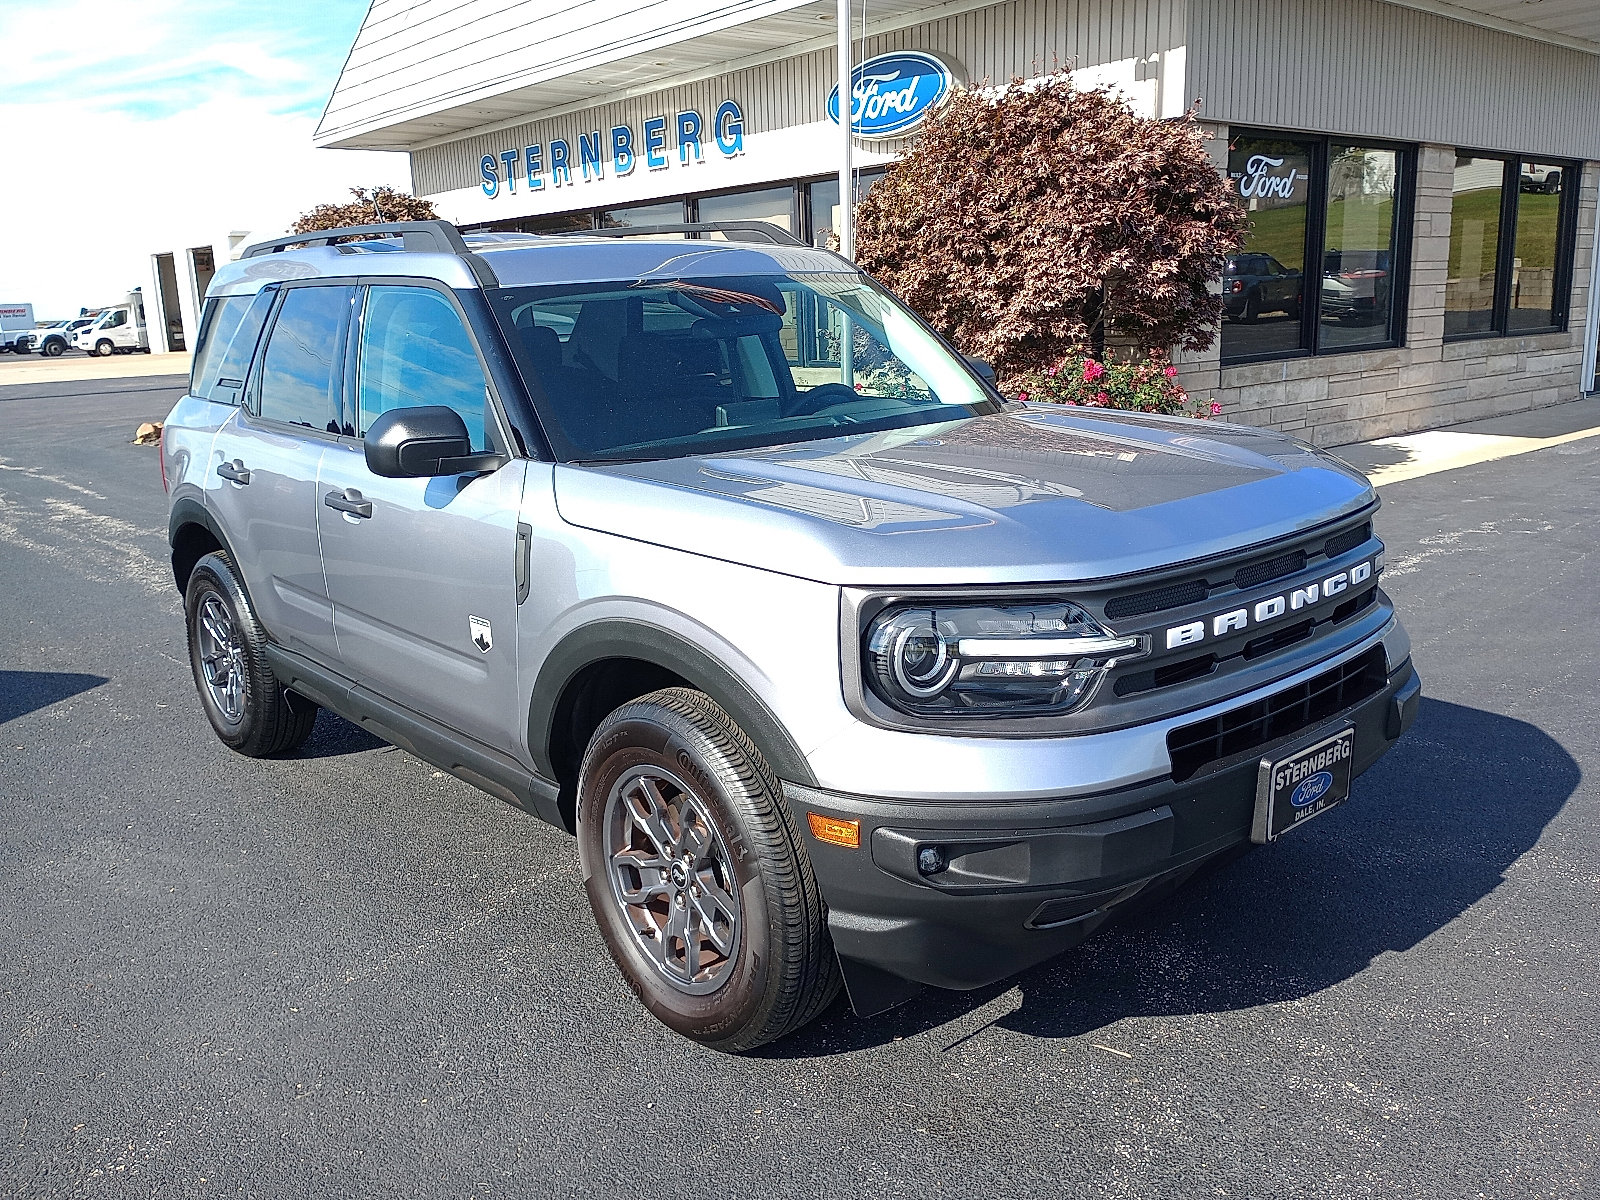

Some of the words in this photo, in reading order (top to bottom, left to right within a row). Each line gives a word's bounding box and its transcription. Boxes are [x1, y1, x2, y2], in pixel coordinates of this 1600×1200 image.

[850, 69, 920, 123] Ford
[479, 99, 745, 199] STERNBERG
[1240, 155, 1296, 198] Ford
[1166, 561, 1371, 650] BRONCO
[1276, 740, 1350, 791] STERNBERG
[1298, 776, 1325, 802] Ford
[1294, 804, 1315, 822] DALE,
[1316, 799, 1326, 811] IN.
